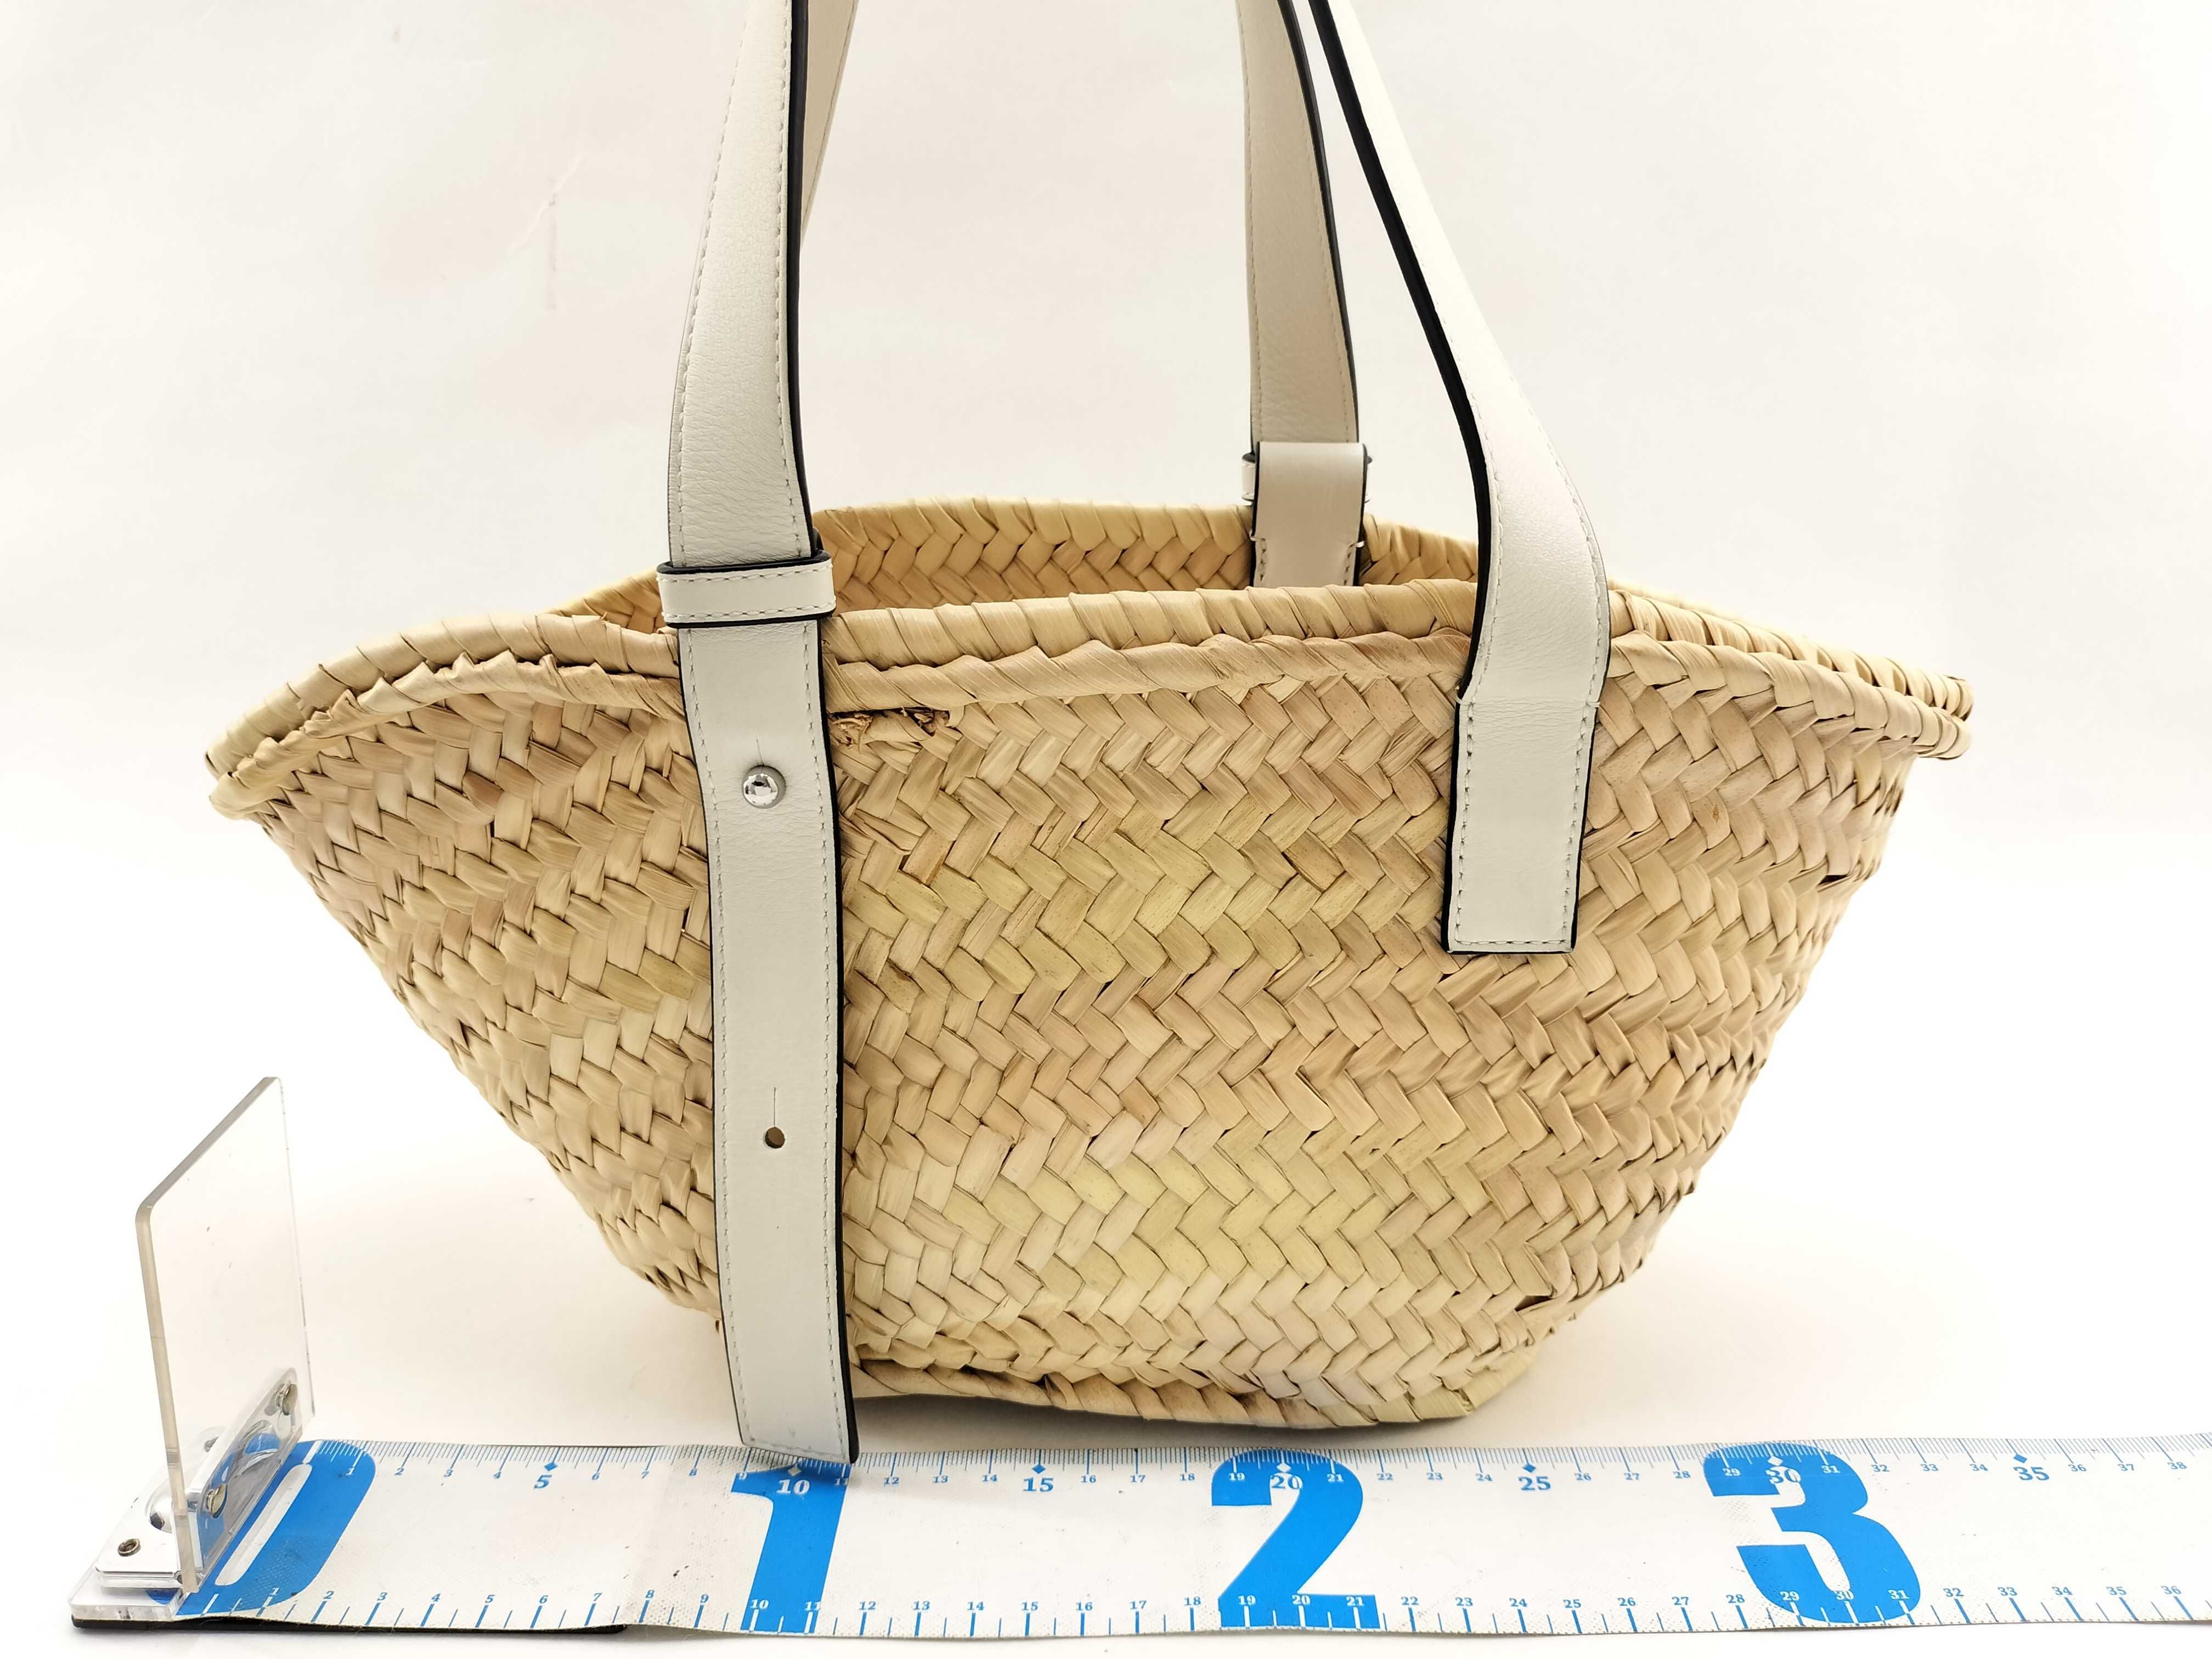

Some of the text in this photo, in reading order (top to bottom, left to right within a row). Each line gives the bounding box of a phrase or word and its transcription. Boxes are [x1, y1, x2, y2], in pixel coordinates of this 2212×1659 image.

[345, 1466, 356, 1475] 1
[394, 1467, 404, 1476] 2
[493, 1471, 502, 1480] 4
[533, 1474, 552, 1490] 5
[591, 1471, 600, 1480] 6
[641, 1471, 650, 1480] 7
[689, 1469, 697, 1477] 8
[738, 1472, 747, 1481] 9
[776, 1479, 810, 1494] 10
[884, 1476, 900, 1485] 12
[933, 1475, 949, 1483] 13
[982, 1474, 997, 1483] 14
[1023, 1477, 1054, 1492] 15
[1081, 1475, 1097, 1483] 16
[1130, 1475, 1146, 1483] 17
[1180, 1474, 1195, 1482] 18
[1229, 1472, 1245, 1482] 19
[1271, 1474, 1302, 1490] 20
[1326, 1472, 1344, 1482] 21
[1377, 1472, 1393, 1481] 22
[1426, 1472, 1443, 1481] 23
[1475, 1473, 1492, 1482] 24
[1518, 1476, 1551, 1492] 25
[1575, 1472, 1592, 1481] 26
[1624, 1472, 1640, 1481] 27
[1673, 1470, 1690, 1479] 28
[1723, 1468, 1741, 1477] 29
[1765, 1468, 1801, 1485] 30
[1821, 1465, 1841, 1474] 31
[1871, 1464, 1889, 1472] 32
[1921, 1464, 1939, 1472] 33
[1970, 1464, 1988, 1472] 34
[2013, 1467, 2050, 1481] 35
[2068, 1464, 2086, 1472] 36
[2167, 1462, 2187, 1470] 38
[730, 1459, 851, 1634] 1
[1211, 1448, 1381, 1630] 2
[1702, 1442, 1921, 1624] 3
[269, 1586, 2181, 1611] 1 2 3 4 5 6 7 8 9 10 11 12 13 14 15 16 17 18 19 20 21 22 23 24 25 26 27 28 29 30 31 32 33 34 35 36
